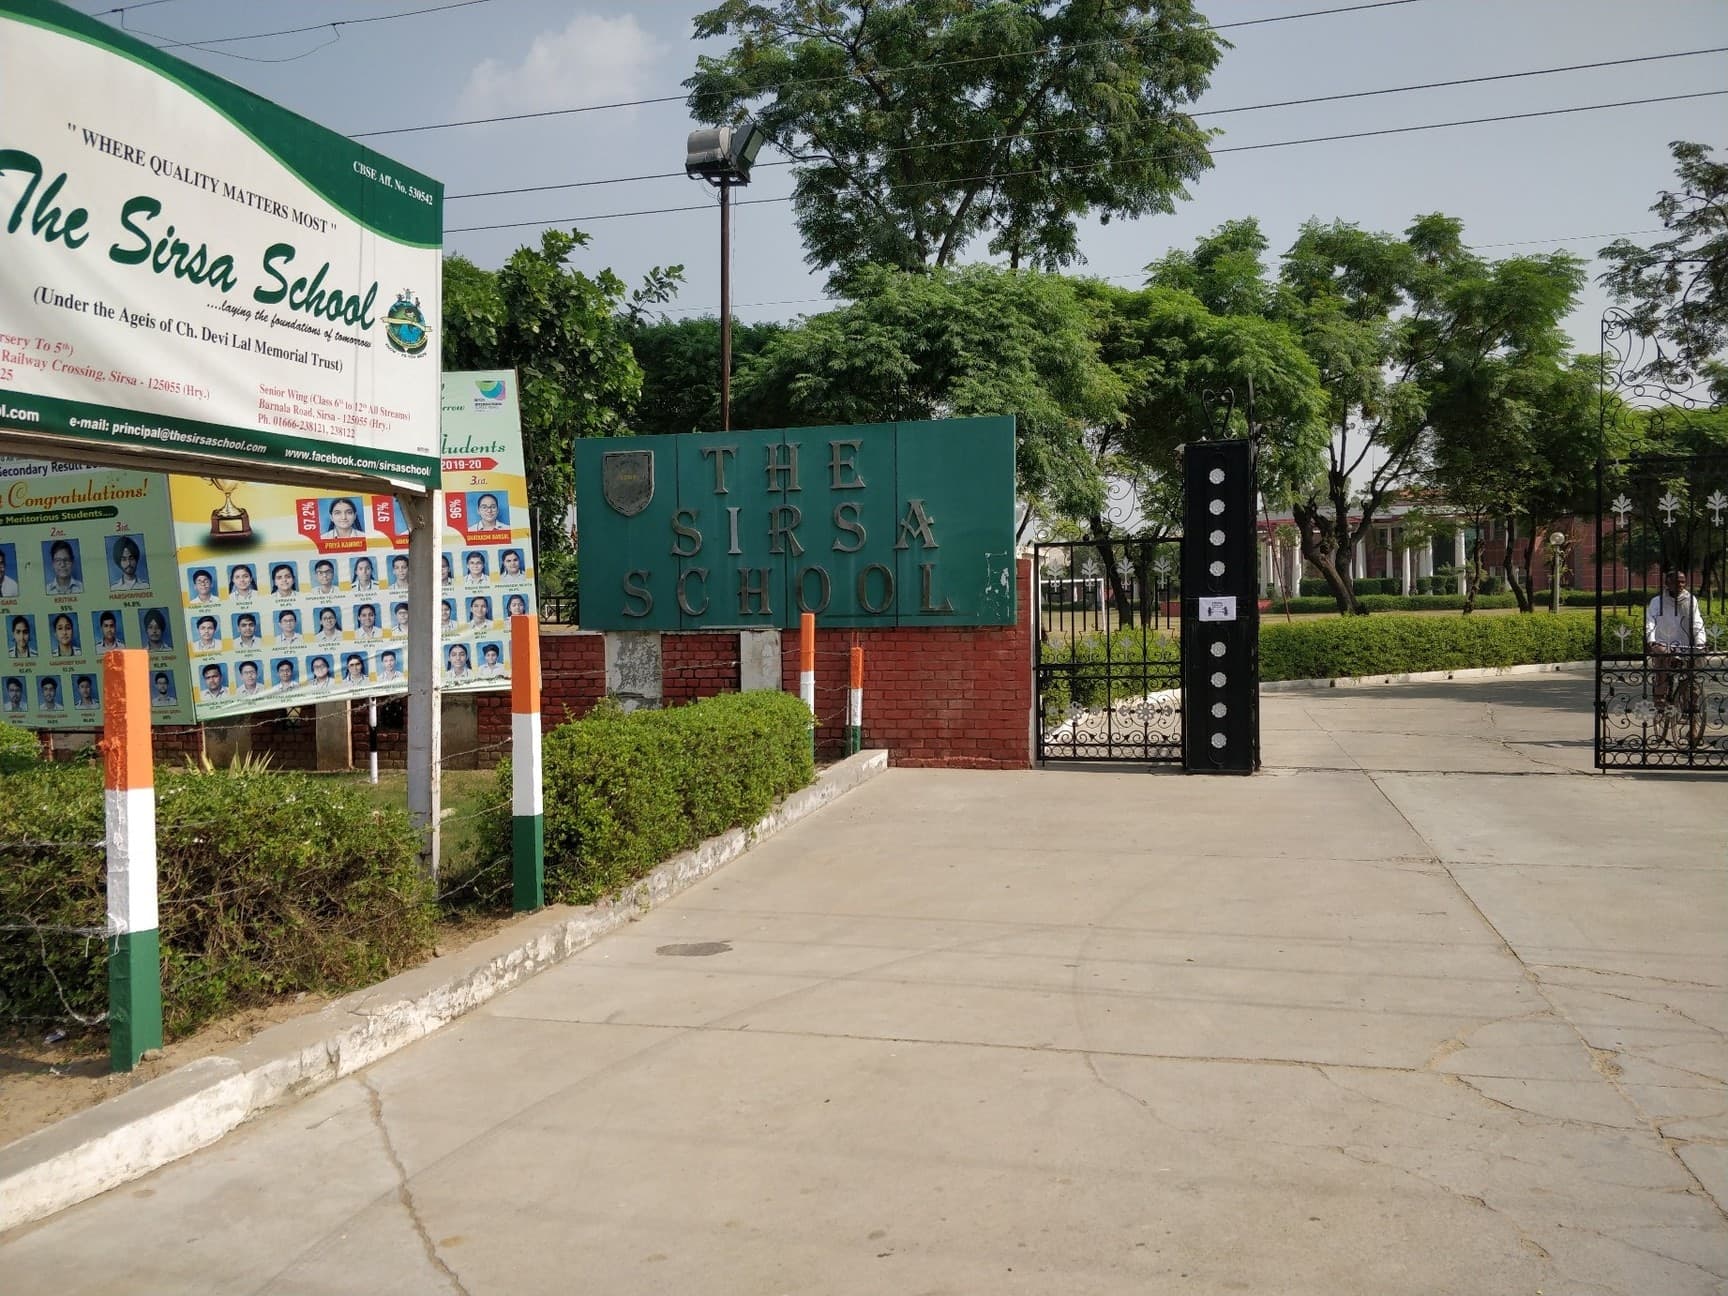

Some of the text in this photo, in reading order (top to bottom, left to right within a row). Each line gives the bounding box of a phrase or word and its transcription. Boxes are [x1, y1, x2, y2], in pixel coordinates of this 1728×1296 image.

[82, 128, 146, 167] WHERE
[150, 155, 220, 194] QUALITY
[223, 182, 289, 220] MATTERS
[291, 208, 328, 233] MOST
[353, 161, 433, 206] CBSE Aff. No. 530542
[0, 149, 378, 331] The Sirsa School
[33, 286, 343, 374] (Under the Ageis of Ch. Devi Lal Memorial Trust)
[255, 308, 269, 322] the
[270, 313, 321, 336] foundations
[324, 328, 333, 341] of
[334, 331, 372, 348] tomorrow
[34, 337, 51, 352] To
[1, 349, 48, 371] Railway
[51, 358, 106, 382] Crossing,
[109, 370, 137, 386] Sirsa
[148, 377, 181, 393] 125055
[258, 398, 291, 414] Barnala
[316, 409, 336, 422] Sirsa
[343, 414, 368, 426] 125055
[259, 383, 286, 398] Senior
[287, 388, 308, 404] Wing
[309, 393, 333, 407] (Class
[368, 405, 378, 415] All
[69, 415, 267, 453] e-mail: principal@thesirsaschool.com
[257, 413, 271, 425] Ph.
[442, 434, 506, 455] tudents
[284, 447, 432, 477] www.facebook.com/sirsaschool/
[441, 459, 482, 470] 2019-20
[700, 439, 866, 495] THE
[8, 478, 148, 510] Congratulations!
[449, 499, 462, 519] 96%
[6, 514, 59, 524] Meritorious
[301, 501, 317, 531] 97.2%
[376, 501, 390, 523] 97%
[671, 499, 940, 558] SIRSA
[622, 562, 953, 617] SCHOOL
